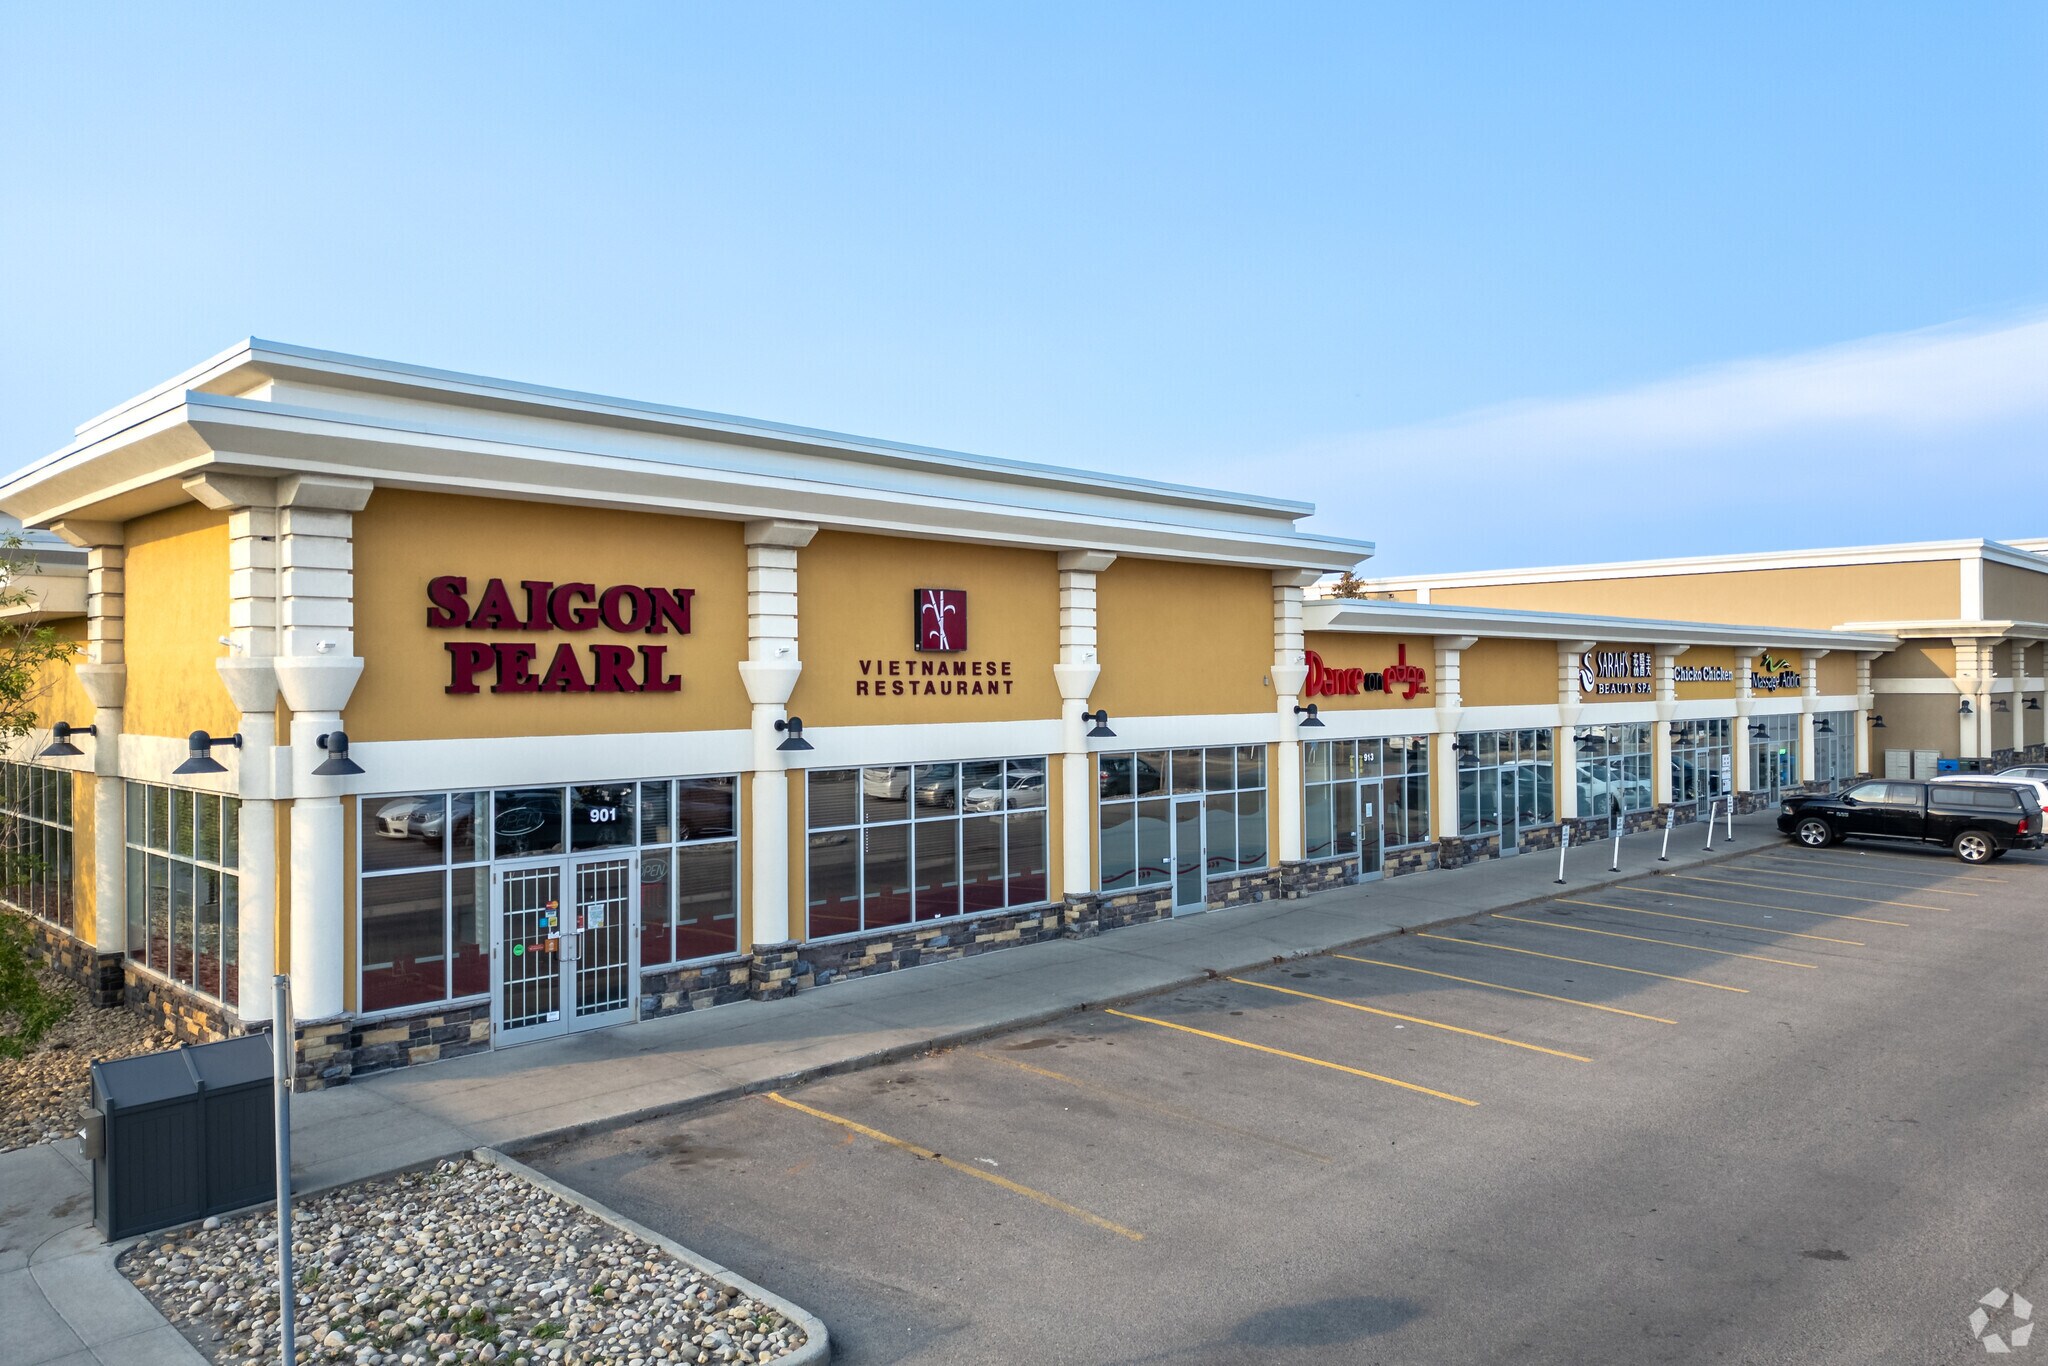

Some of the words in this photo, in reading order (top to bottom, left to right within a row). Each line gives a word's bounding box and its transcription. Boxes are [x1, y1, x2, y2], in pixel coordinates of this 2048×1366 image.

[427, 576, 695, 634] SAIGON
[444, 642, 682, 694] PEARL
[859, 660, 1012, 676] VIETNAMESE
[1305, 650, 1364, 697] Dance
[1364, 673, 1383, 691] on
[1383, 644, 1425, 700] edge
[1596, 651, 1630, 677] SARAH'S
[1674, 666, 1702, 681] Chicko
[1702, 666, 1733, 681] Chicken
[856, 680, 1014, 696] RESTAURANT
[1597, 683, 1633, 694] BEAUTY
[1636, 683, 1652, 693] SPA
[1751, 672, 1780, 692] Massage
[1363, 752, 1374, 762] 913
[590, 807, 616, 823] 901
